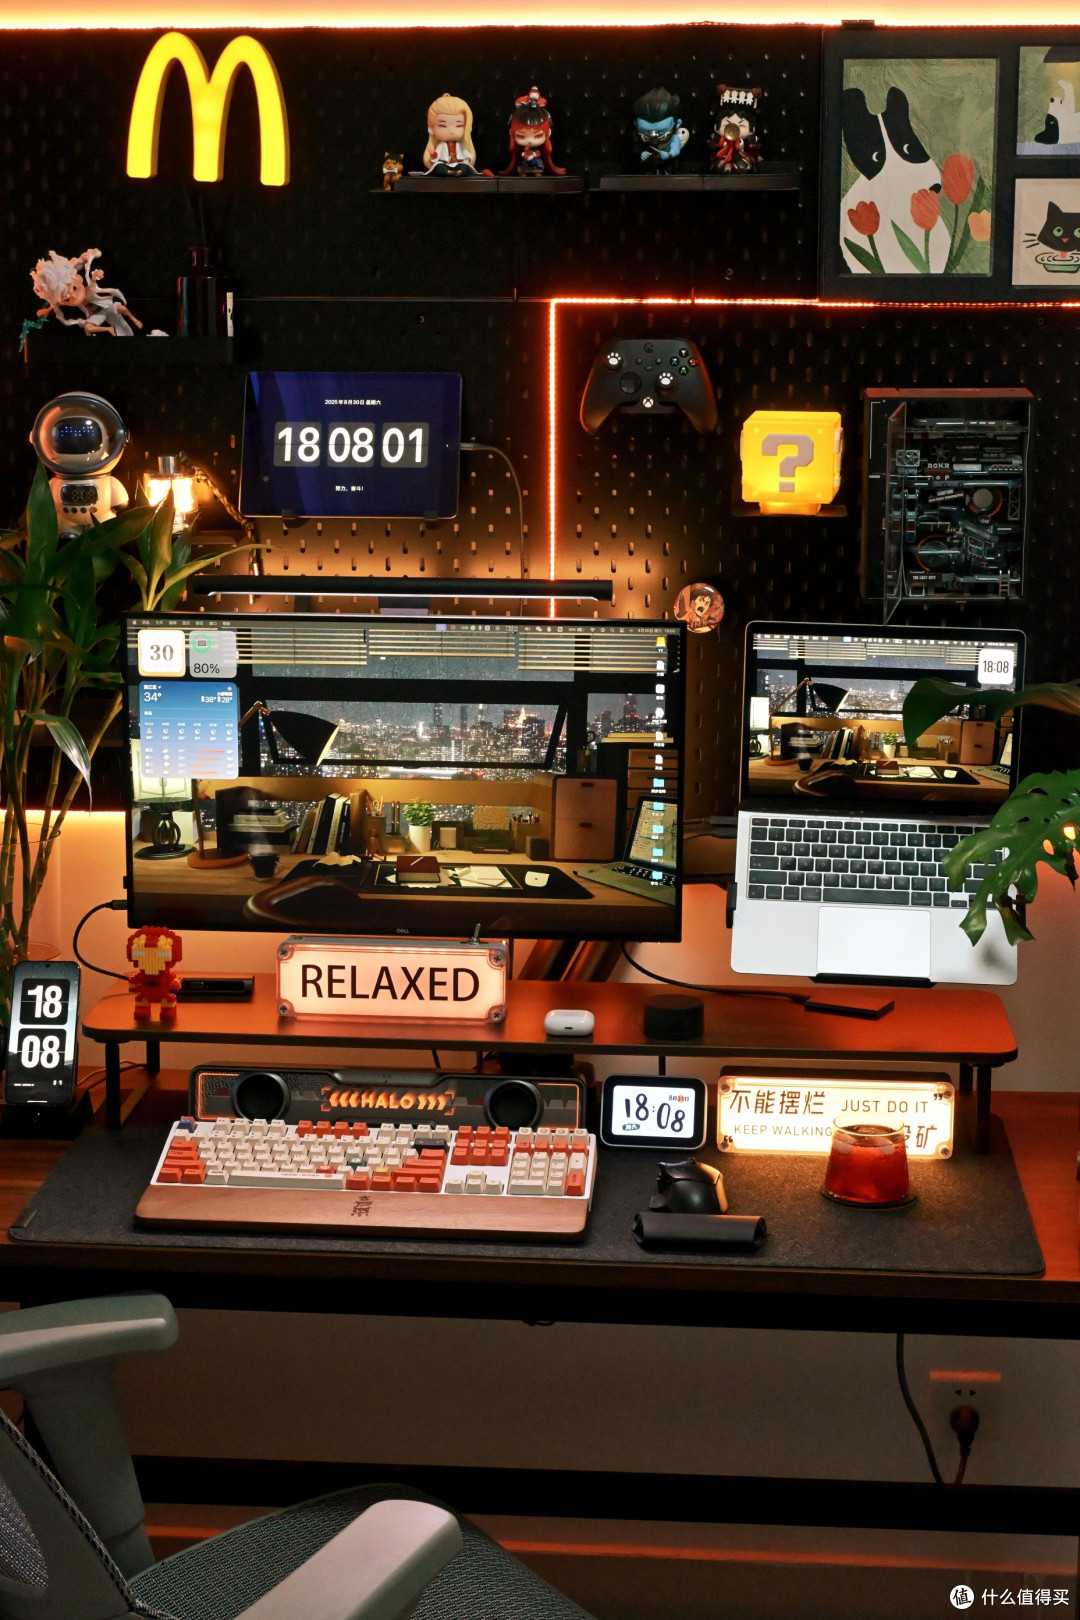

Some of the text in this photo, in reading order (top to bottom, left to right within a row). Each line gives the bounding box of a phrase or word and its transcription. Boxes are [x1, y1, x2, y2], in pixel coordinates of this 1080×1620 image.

[277, 427, 423, 463] 18 08 01
[150, 644, 174, 661] 30
[193, 662, 220, 674] 80%
[983, 660, 1010, 674] 18:08
[143, 691, 162, 702] 34°
[301, 964, 480, 1002] RELAXED
[27, 985, 63, 1018] 18
[21, 1035, 60, 1069] 08
[361, 1091, 416, 1110] HALO
[730, 1090, 826, 1115] 不能摆烂
[841, 1100, 929, 1113] JUST DO IT
[624, 1093, 686, 1133] 18:08
[734, 1124, 833, 1137] KEEP WALKING
